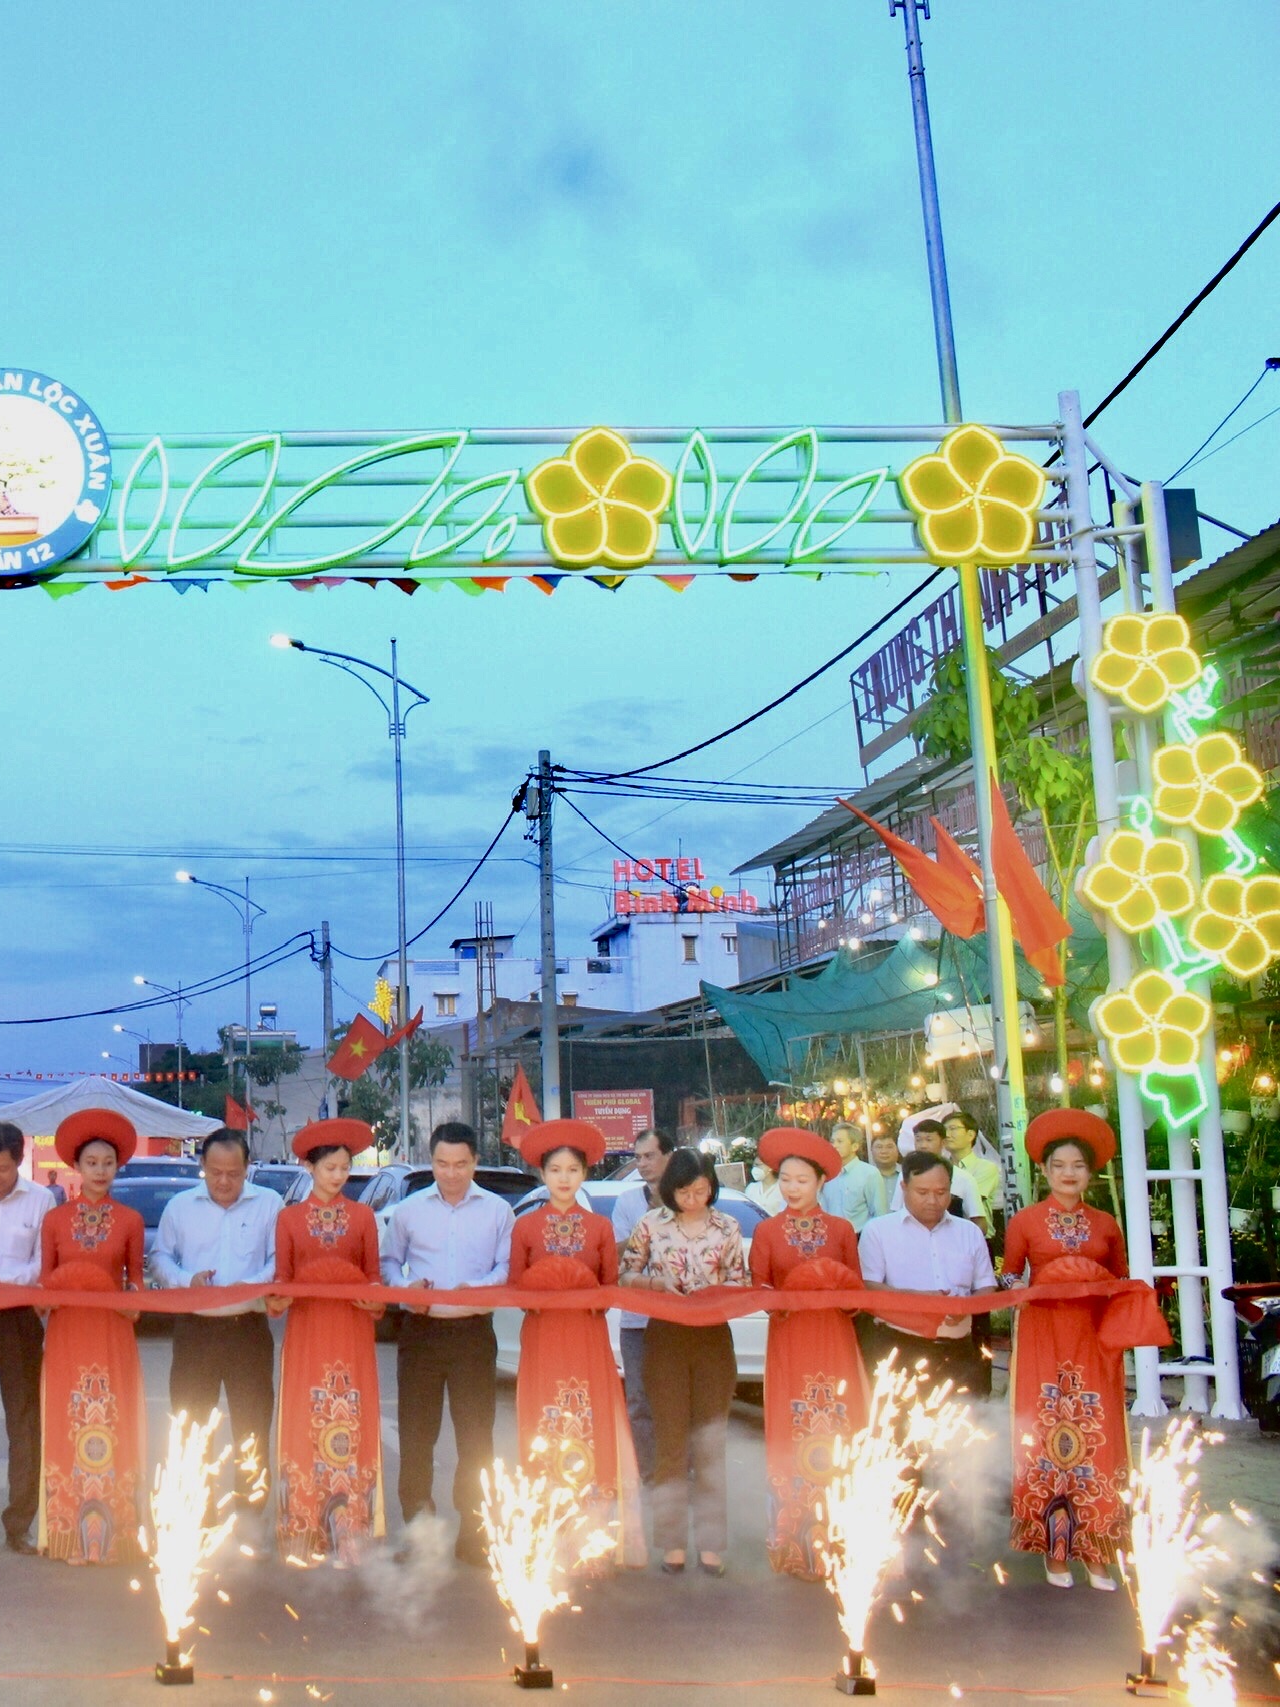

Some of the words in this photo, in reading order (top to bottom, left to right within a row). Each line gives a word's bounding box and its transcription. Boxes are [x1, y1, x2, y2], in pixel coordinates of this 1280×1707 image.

[29, 377, 79, 413] LỘC
[74, 413, 110, 490] XUÂN
[26, 543, 55, 564] 12
[859, 617, 926, 724] TRUNG
[614, 858, 707, 882] HOTEL
[687, 886, 758, 913] Minh
